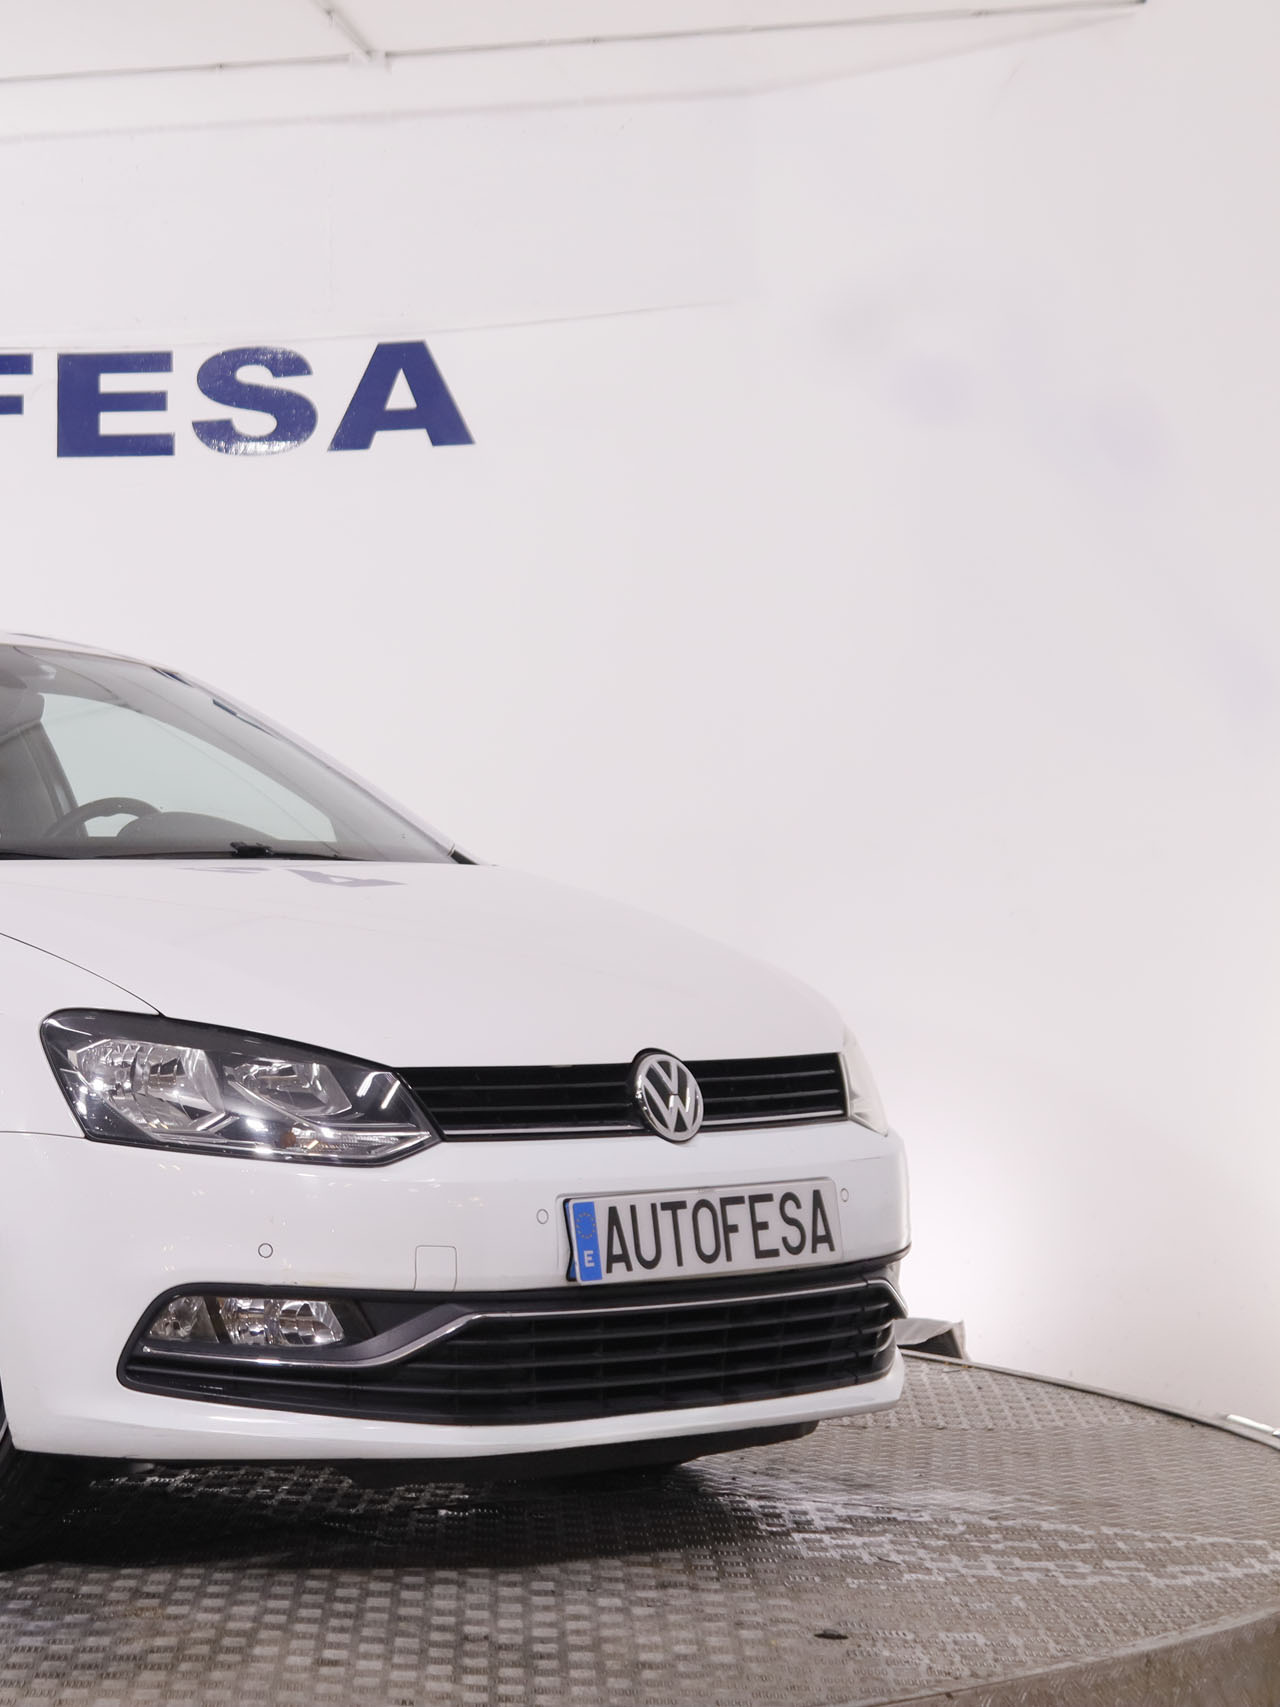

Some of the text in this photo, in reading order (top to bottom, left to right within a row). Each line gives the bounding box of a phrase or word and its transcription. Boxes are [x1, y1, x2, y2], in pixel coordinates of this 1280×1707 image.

[638, 1054, 703, 1139] VW
[584, 1250, 595, 1268] E
[606, 1189, 835, 1274] AUTOFESA
